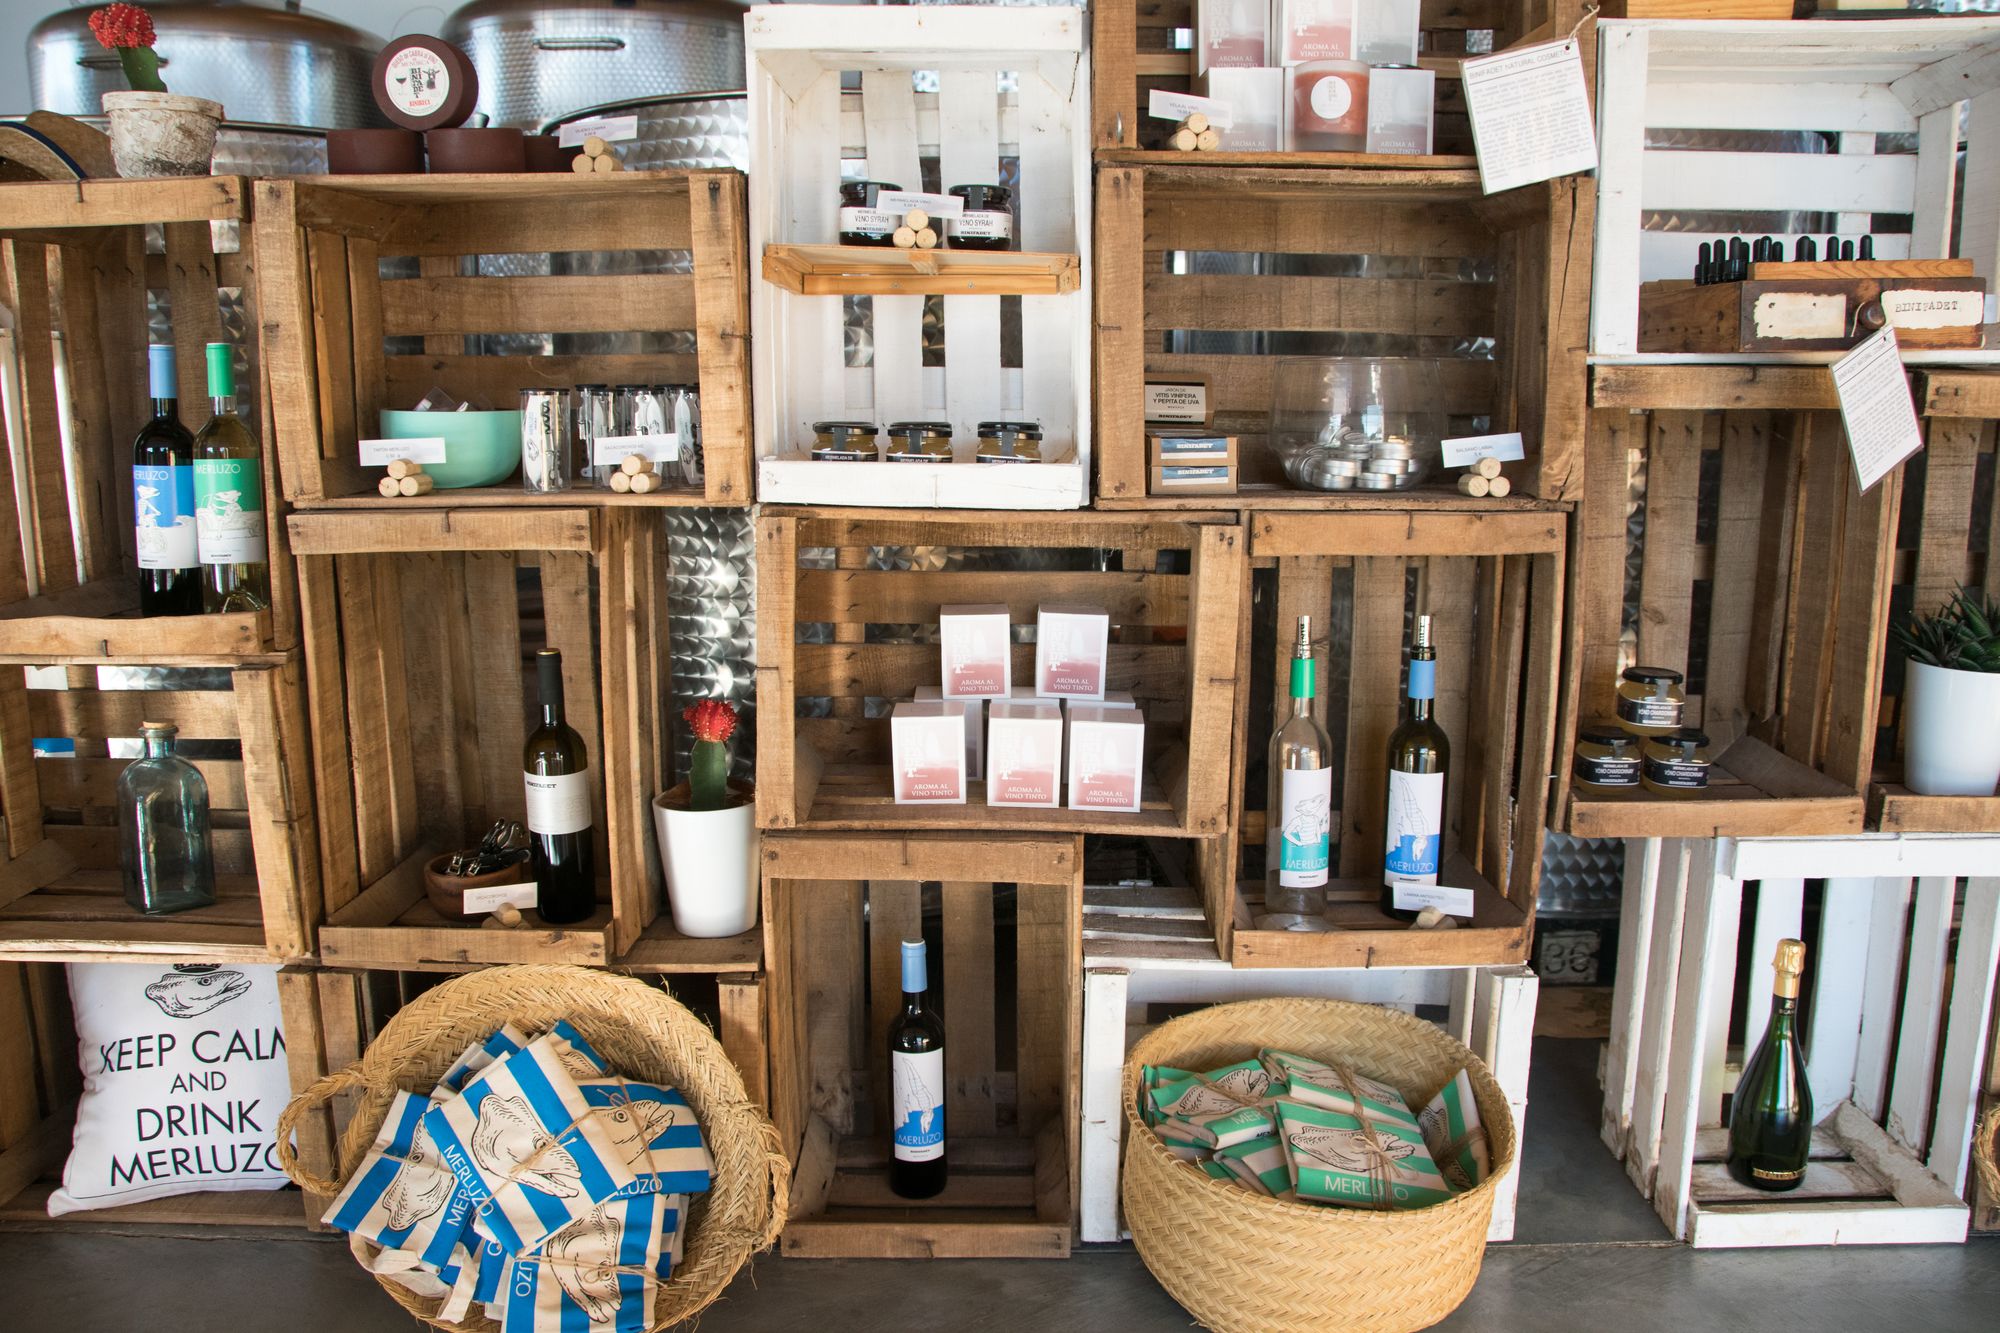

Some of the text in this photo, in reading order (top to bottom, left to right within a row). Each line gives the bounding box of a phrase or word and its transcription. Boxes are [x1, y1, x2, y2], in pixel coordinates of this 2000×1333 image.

[855, 215, 890, 223] VINO SYRAH
[959, 219, 993, 227] VINO SYRAH
[1895, 300, 1959, 313] BINIFADET
[1053, 683, 1071, 691] VINO
[911, 789, 931, 797] VINO
[1088, 790, 1123, 798] AROMA AL
[1086, 796, 1105, 804] VINO
[1286, 857, 1328, 870] MERLUZO
[1389, 859, 1435, 873] MERLUZO
[1545, 941, 1590, 974] 36
[100, 1033, 176, 1075] KEEP
[170, 1071, 227, 1094] AND
[137, 1099, 262, 1142] DRINK
[898, 1132, 942, 1145] MERLUZO
[110, 1142, 298, 1187] MERLUZO
[443, 1143, 495, 1217] MERLUZO
[1325, 1174, 1409, 1201] MERLUO
